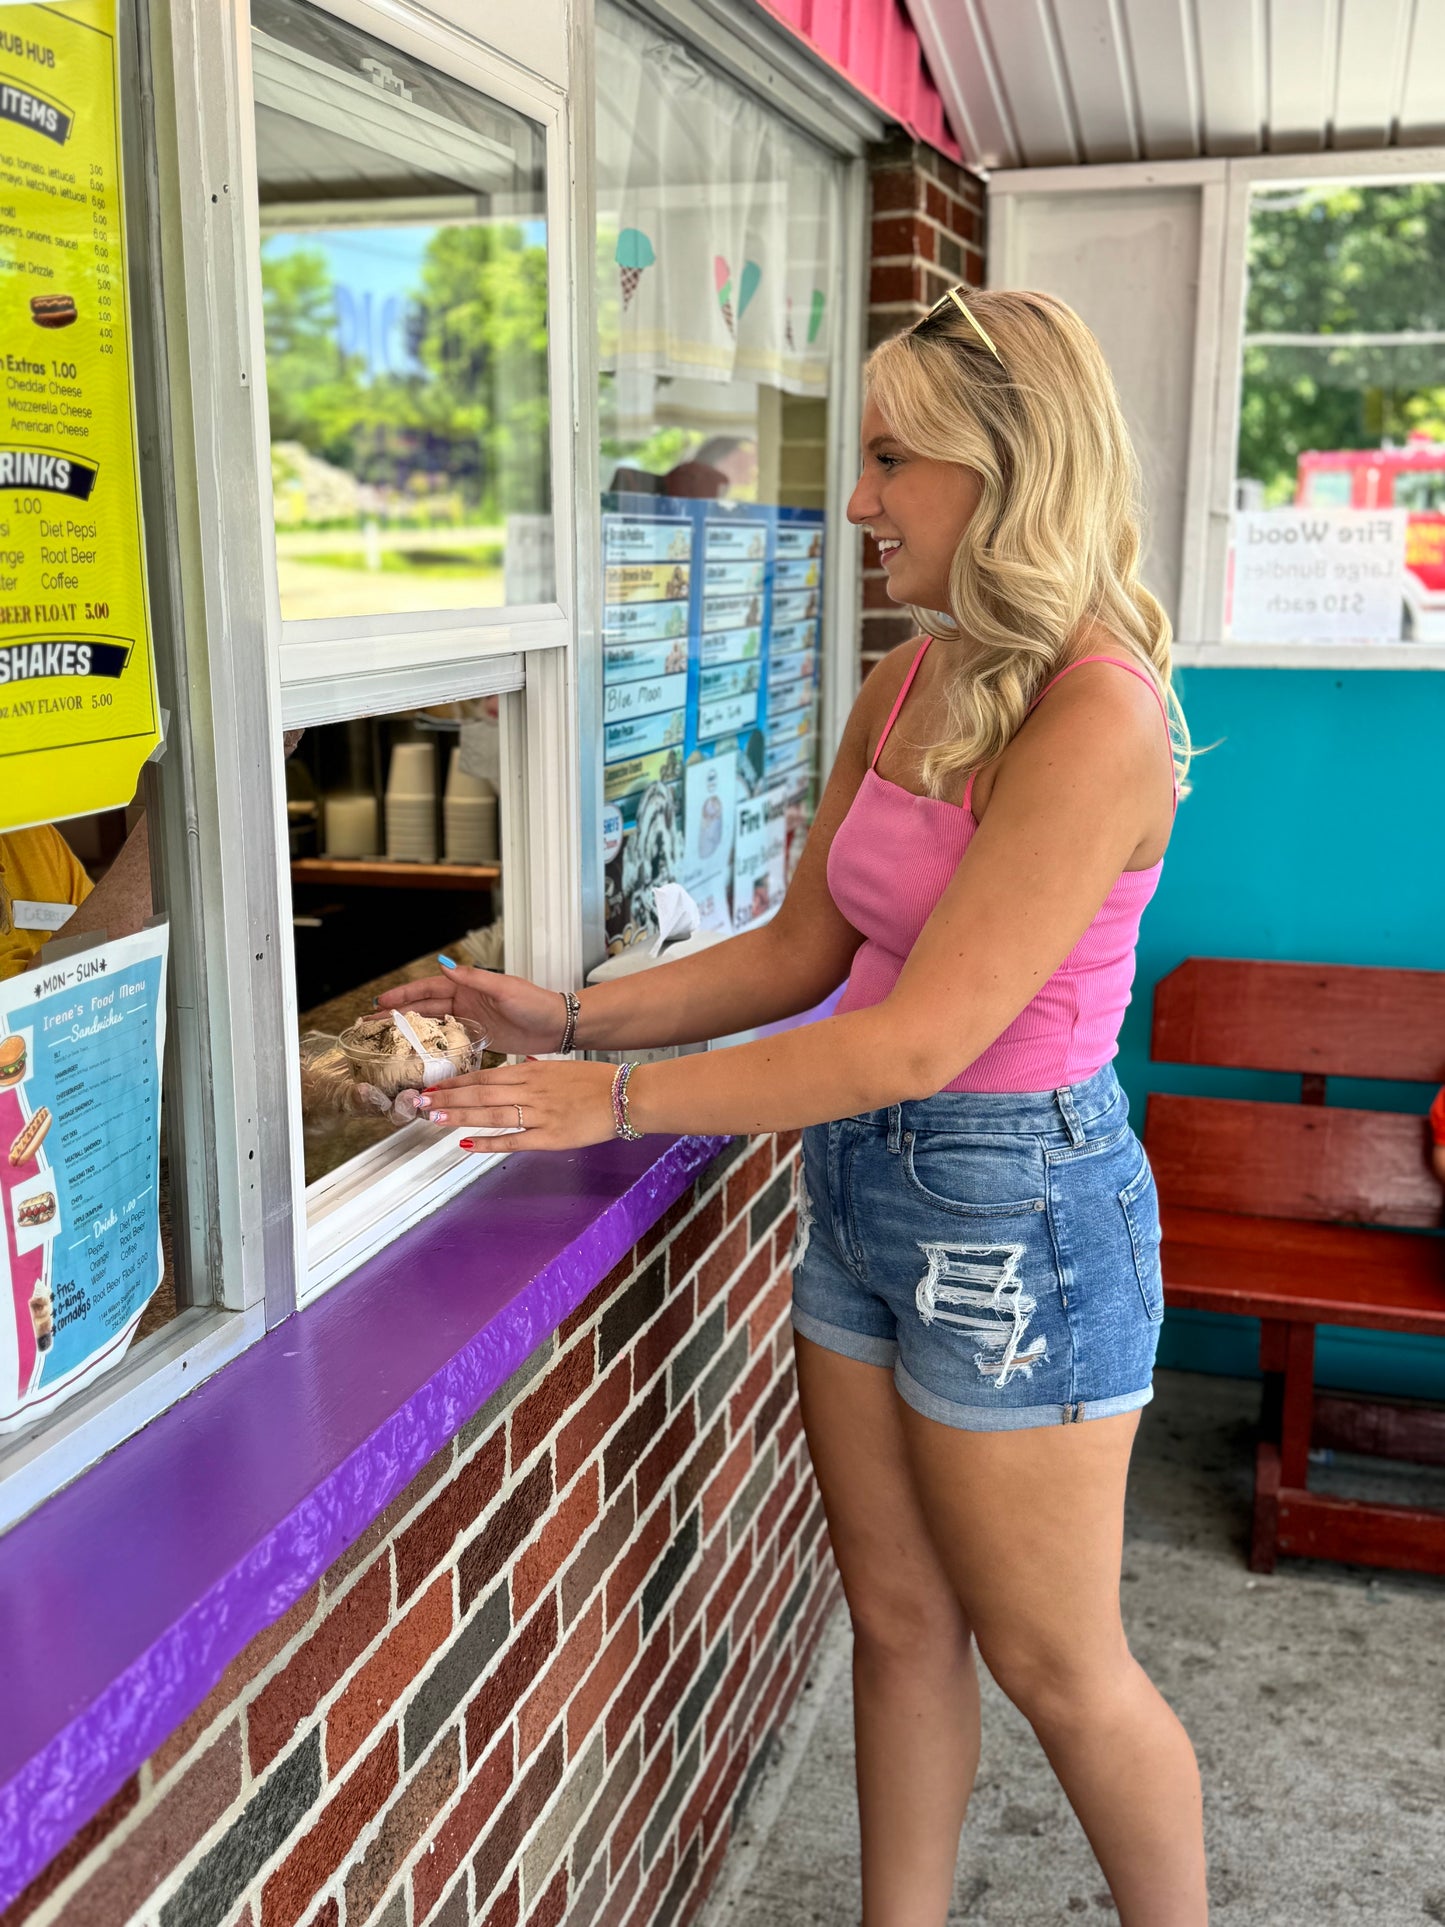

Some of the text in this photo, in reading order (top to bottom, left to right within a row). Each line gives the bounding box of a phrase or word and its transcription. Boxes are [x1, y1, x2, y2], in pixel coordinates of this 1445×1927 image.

[26, 40, 55, 68] HUB
[2, 86, 58, 132] ITEMS
[95, 245, 109, 257] 6.00
[100, 328, 113, 338] 4.00
[100, 344, 113, 354] 4.00
[7, 354, 45, 375] Extras
[52, 360, 77, 379] 1.00
[7, 377, 82, 398] Cheddar Cheese
[7, 397, 92, 418] Mozzerella Cheese
[11, 417, 89, 437] American Cheese
[14, 498, 42, 514] 1.00
[40, 520, 97, 541] Diet Pepsi
[41, 547, 96, 564] Root Beer
[41, 572, 78, 590] Coffee
[35, 603, 77, 622] FLOAT
[85, 602, 109, 620] 5.00
[0, 643, 92, 684] SHAKES
[12, 700, 35, 718] ANY
[38, 695, 83, 714] FLAVOR
[92, 693, 112, 709] 5.00
[607, 686, 662, 712] Blue Moon
[43, 980, 146, 1031] Irene's Food Menu
[70, 1008, 124, 1042] Sandwiches
[93, 1208, 118, 1238] Drinks
